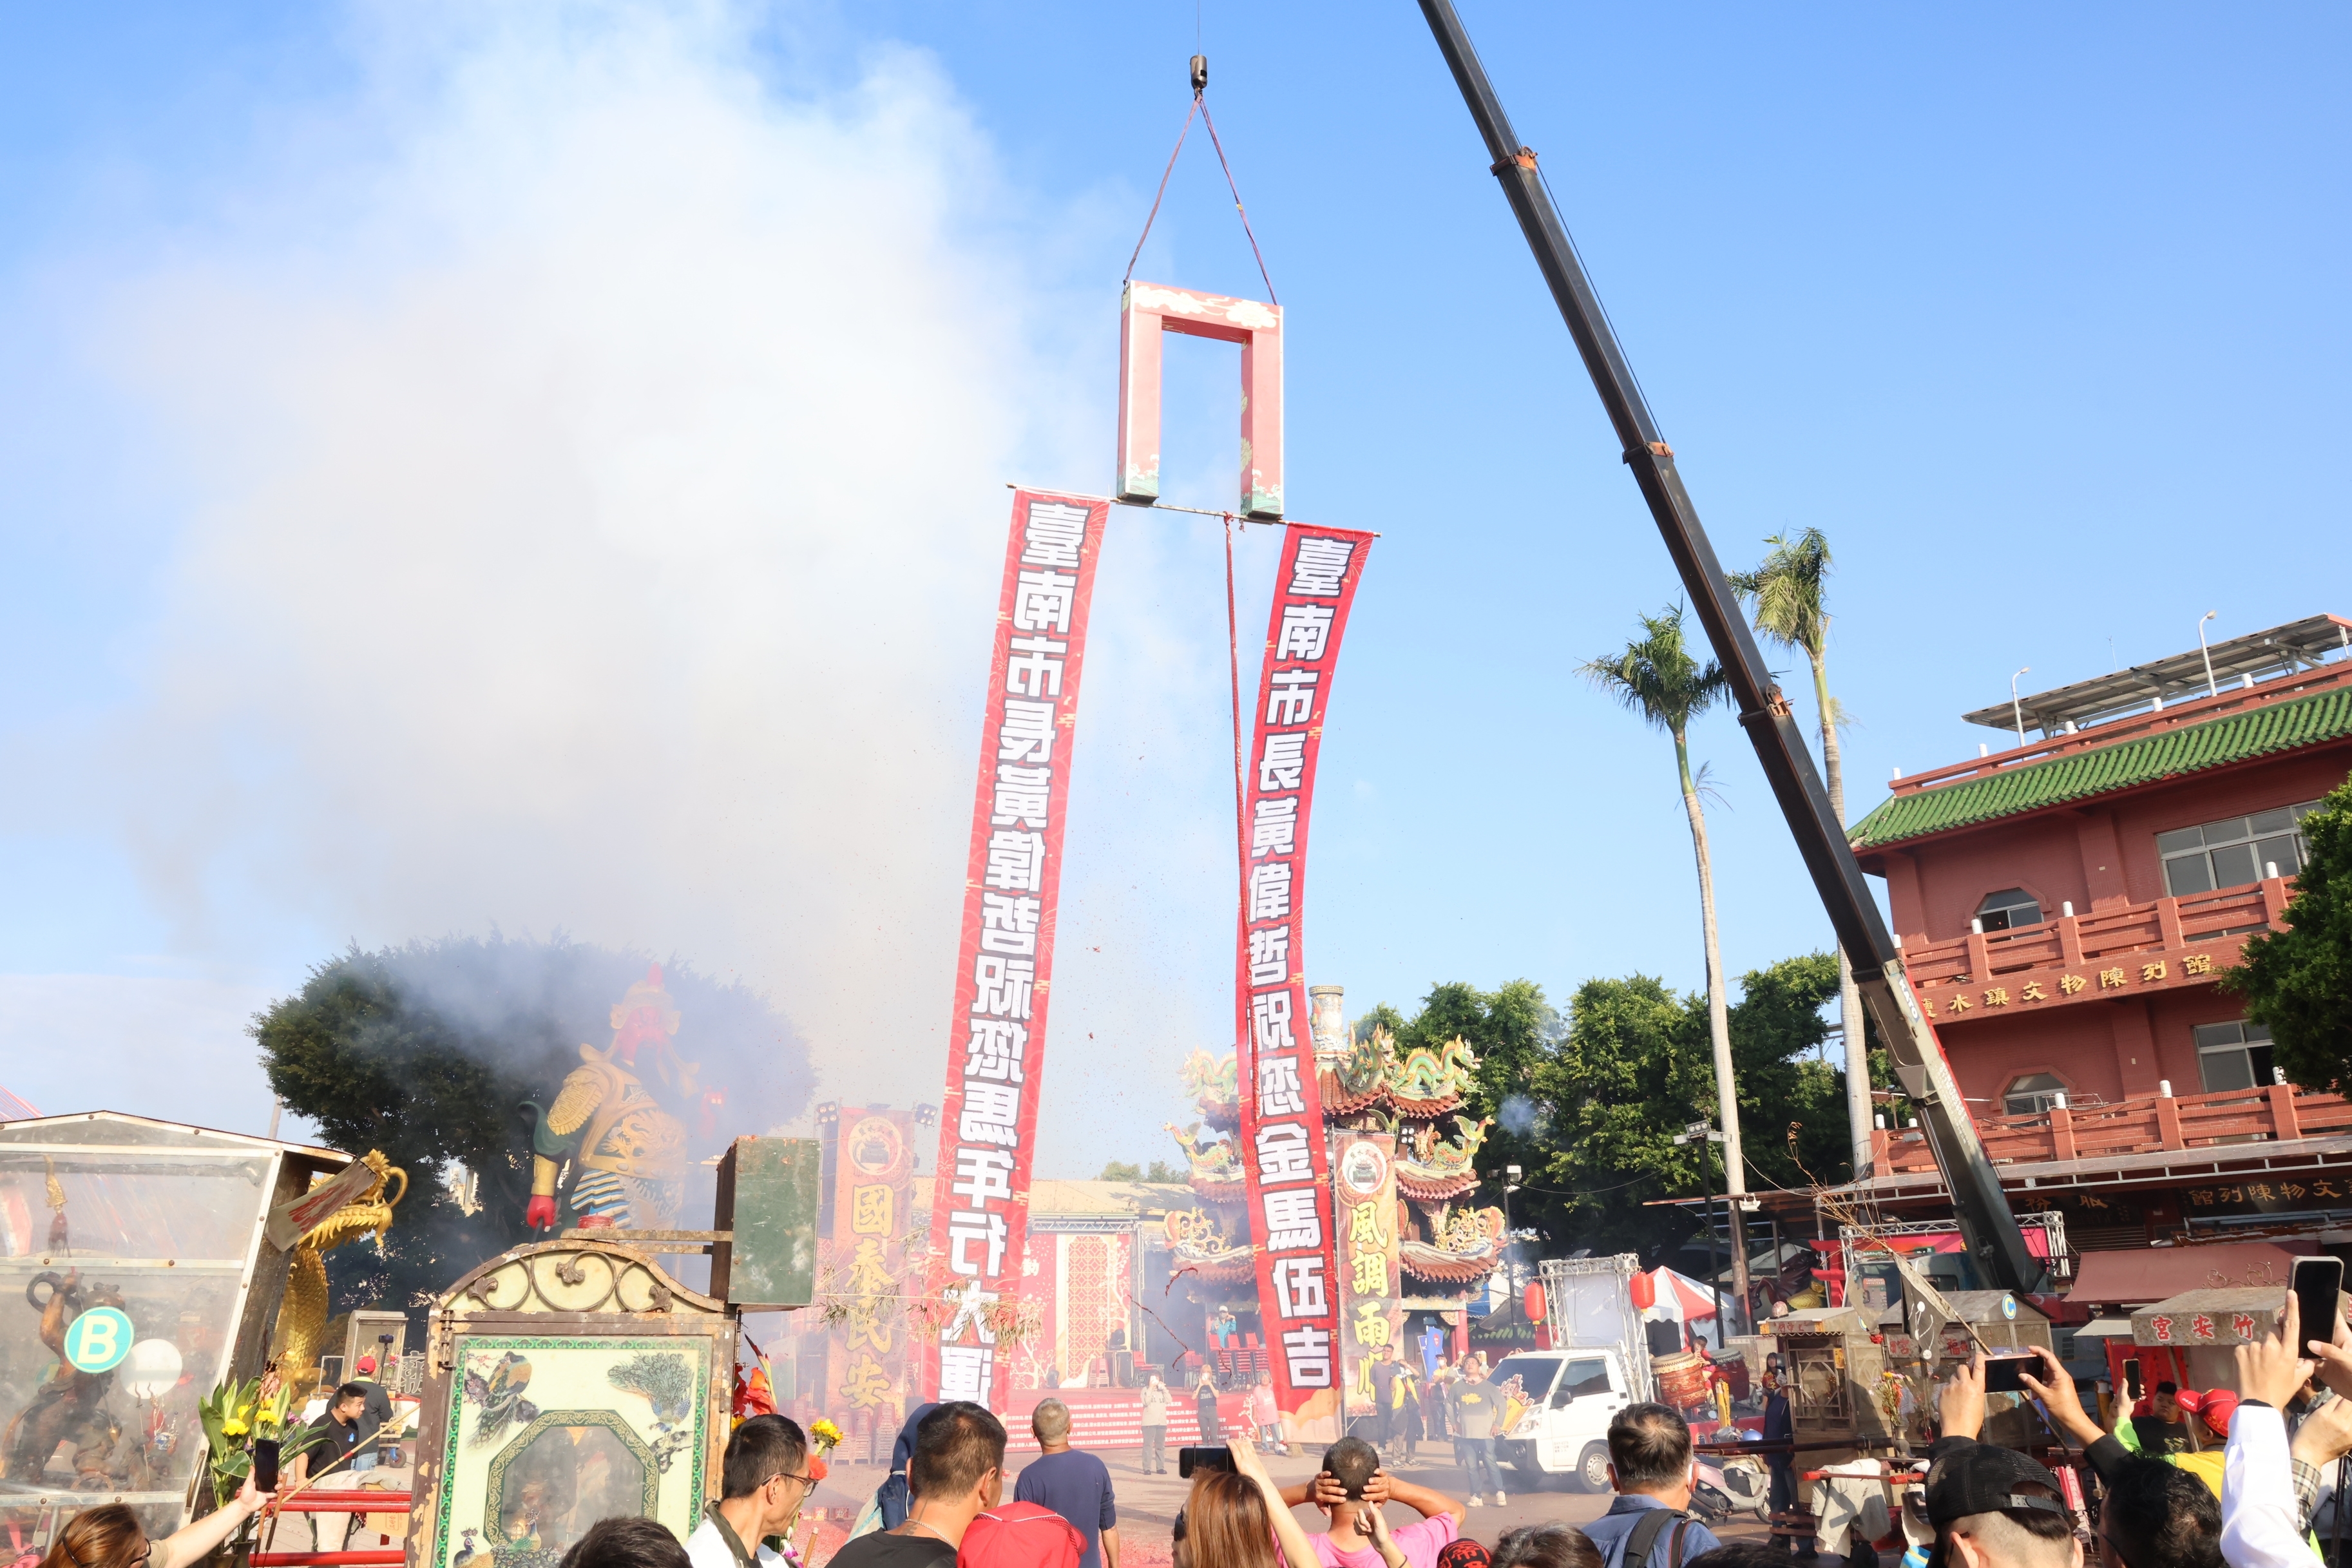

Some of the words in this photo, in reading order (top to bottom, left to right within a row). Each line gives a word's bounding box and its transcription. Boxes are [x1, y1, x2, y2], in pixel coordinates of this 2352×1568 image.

[1247, 536, 1355, 1388] 臺南市長黃偉哲祝您金馬伍吉
[1899, 979, 1918, 1019] KATO
[839, 1184, 894, 1410] 國泰民安
[2004, 1297, 2014, 1317] C
[76, 1315, 119, 1364] B
